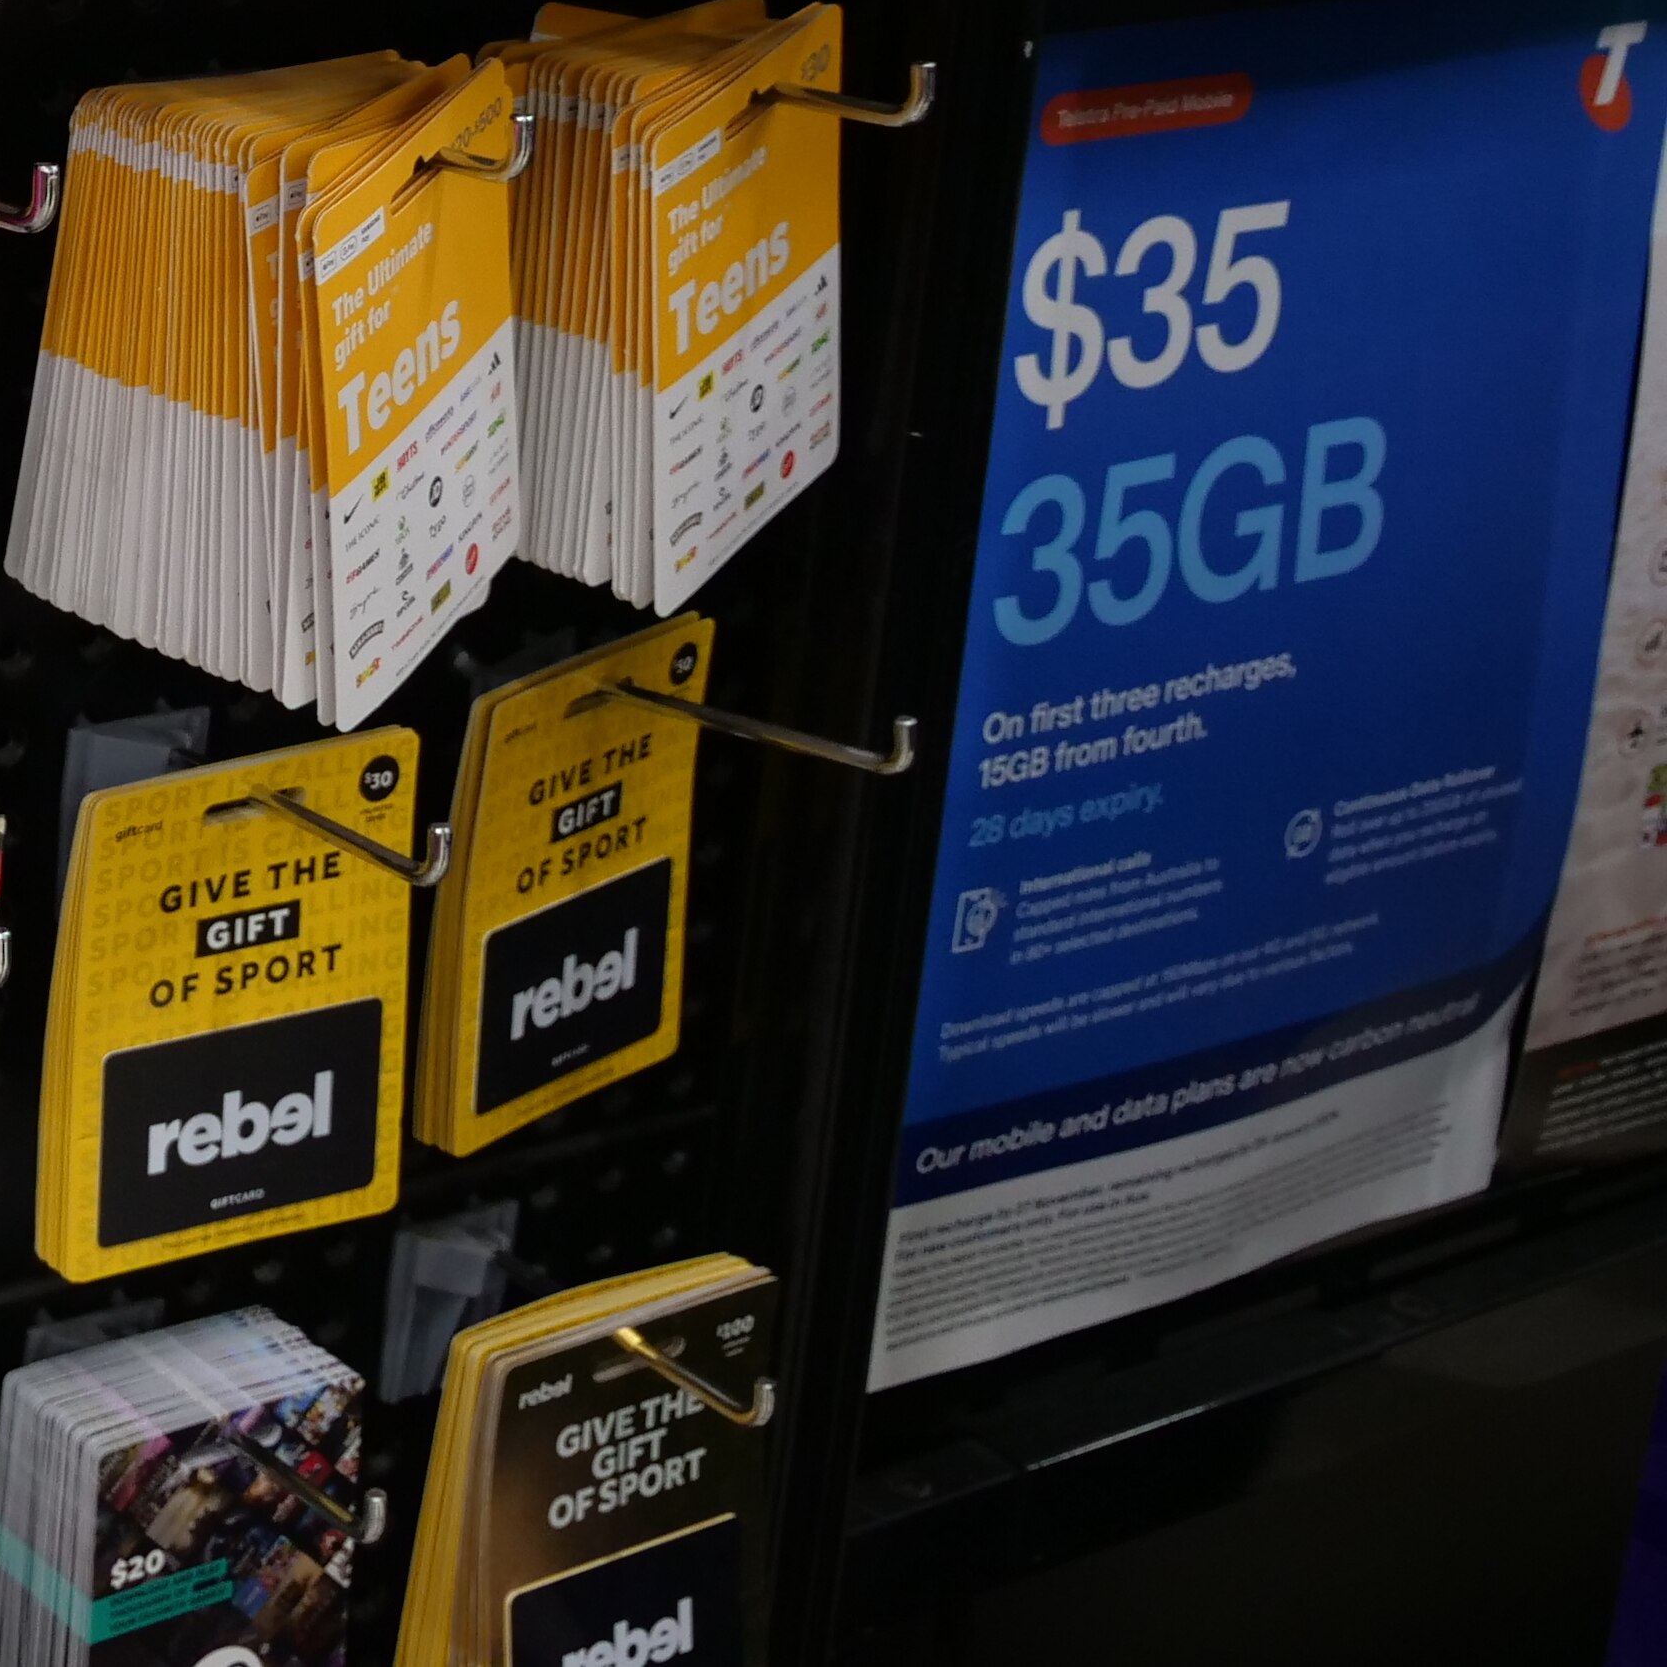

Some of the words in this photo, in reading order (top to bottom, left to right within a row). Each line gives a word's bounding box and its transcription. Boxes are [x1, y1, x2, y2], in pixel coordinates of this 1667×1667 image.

[330, 287, 364, 328] The
[367, 222, 434, 298] Ultimate
[667, 220, 790, 356] Teens
[1014, 201, 1290, 430] $35
[337, 298, 461, 456] Teens
[993, 416, 1387, 647] 35GB
[365, 768, 395, 791] $30
[978, 745, 1048, 789] 15GB
[1055, 733, 1116, 770] from
[1123, 713, 1208, 756] fourth.
[159, 871, 251, 914] GIVE
[268, 853, 343, 890] THE
[206, 908, 291, 950] GIFT
[149, 972, 198, 1008] OF
[214, 945, 343, 996] SPORT
[510, 928, 638, 1041] rebel
[147, 1070, 334, 1175] rebel
[592, 1428, 666, 1479] GIFT
[109, 1549, 166, 1587] $20
